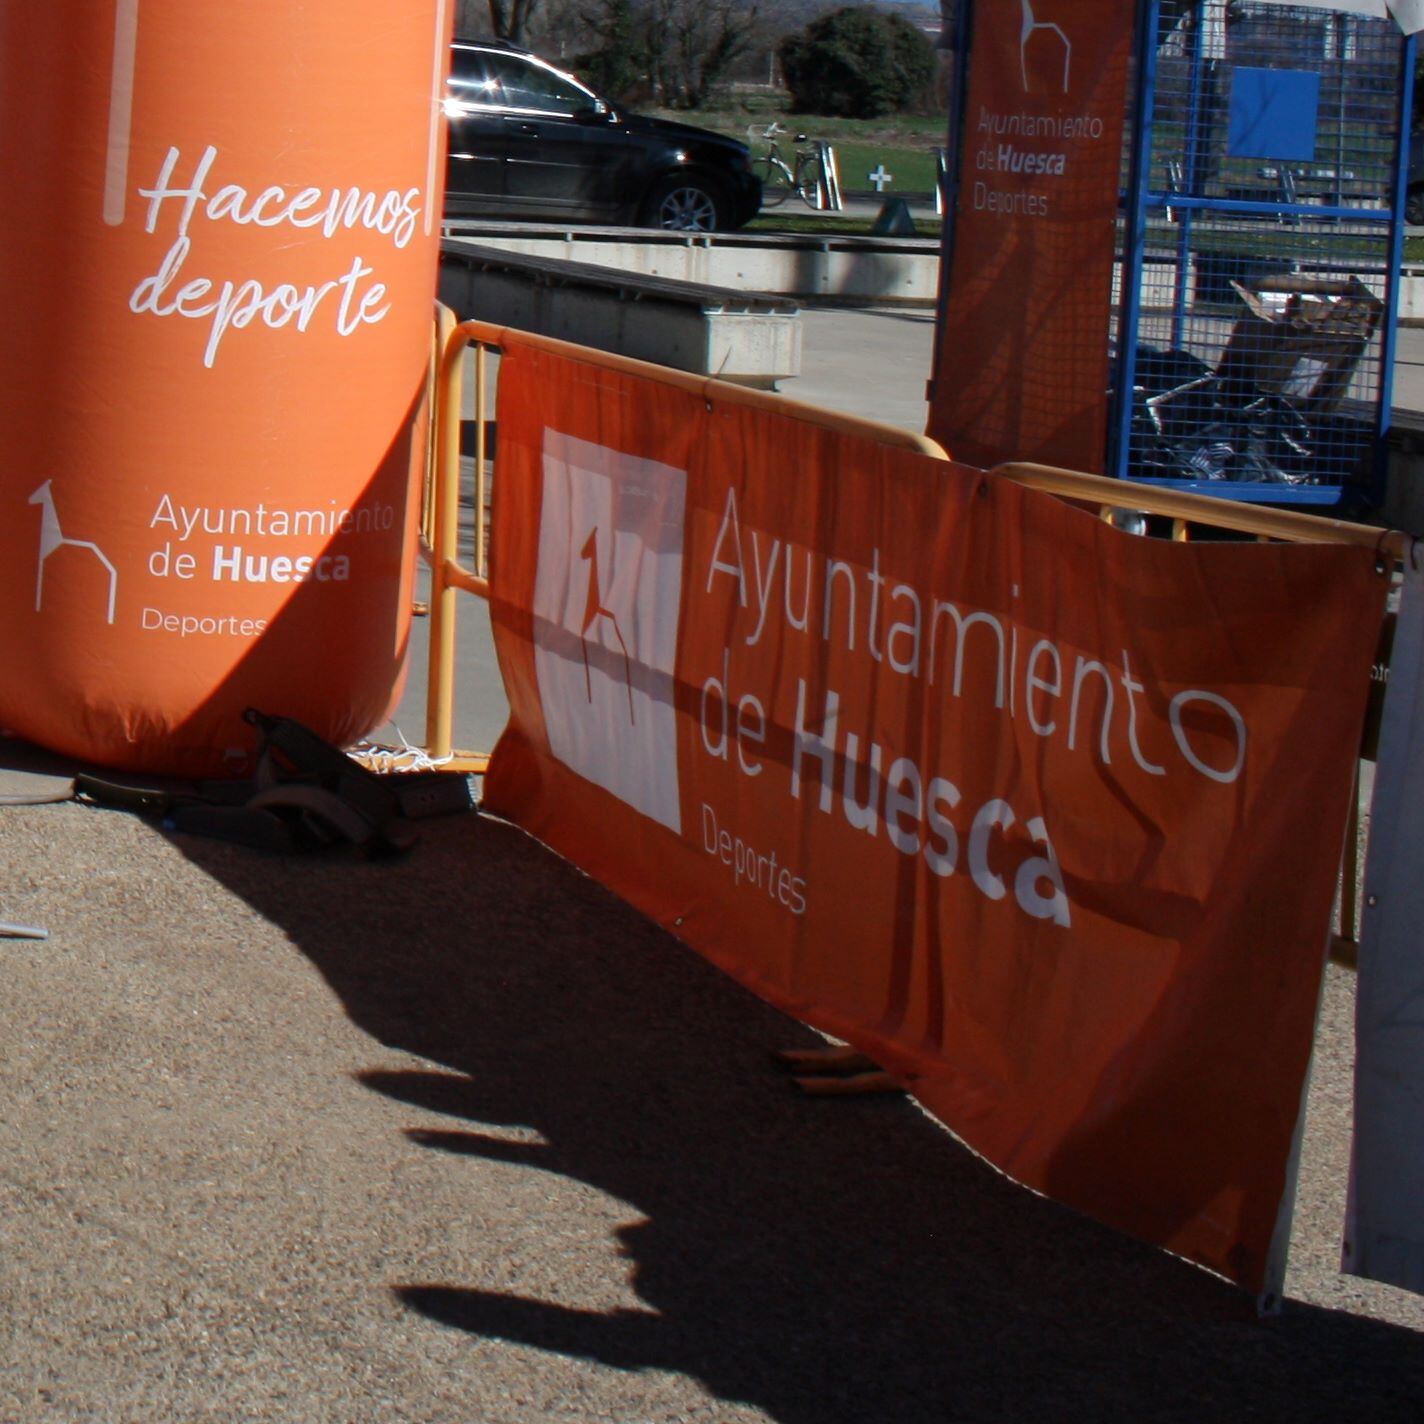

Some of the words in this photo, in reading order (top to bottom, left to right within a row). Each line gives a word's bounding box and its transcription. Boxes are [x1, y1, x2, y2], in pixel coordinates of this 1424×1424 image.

[978, 106, 1103, 142] Ayuntamiento
[976, 143, 993, 170] de
[997, 144, 1067, 175] Huesca
[138, 146, 422, 248] Hacemos
[973, 181, 1048, 219] Deportes
[129, 235, 391, 368] deporte
[150, 494, 394, 542] Ayuntamiento
[149, 542, 196, 579] de
[212, 545, 351, 583] Huesca
[142, 607, 269, 637] Deportes
[706, 487, 1247, 783] Ayuntamiento
[701, 648, 765, 776] de
[791, 678, 1072, 928] Huesca
[702, 802, 808, 915] Deportes
